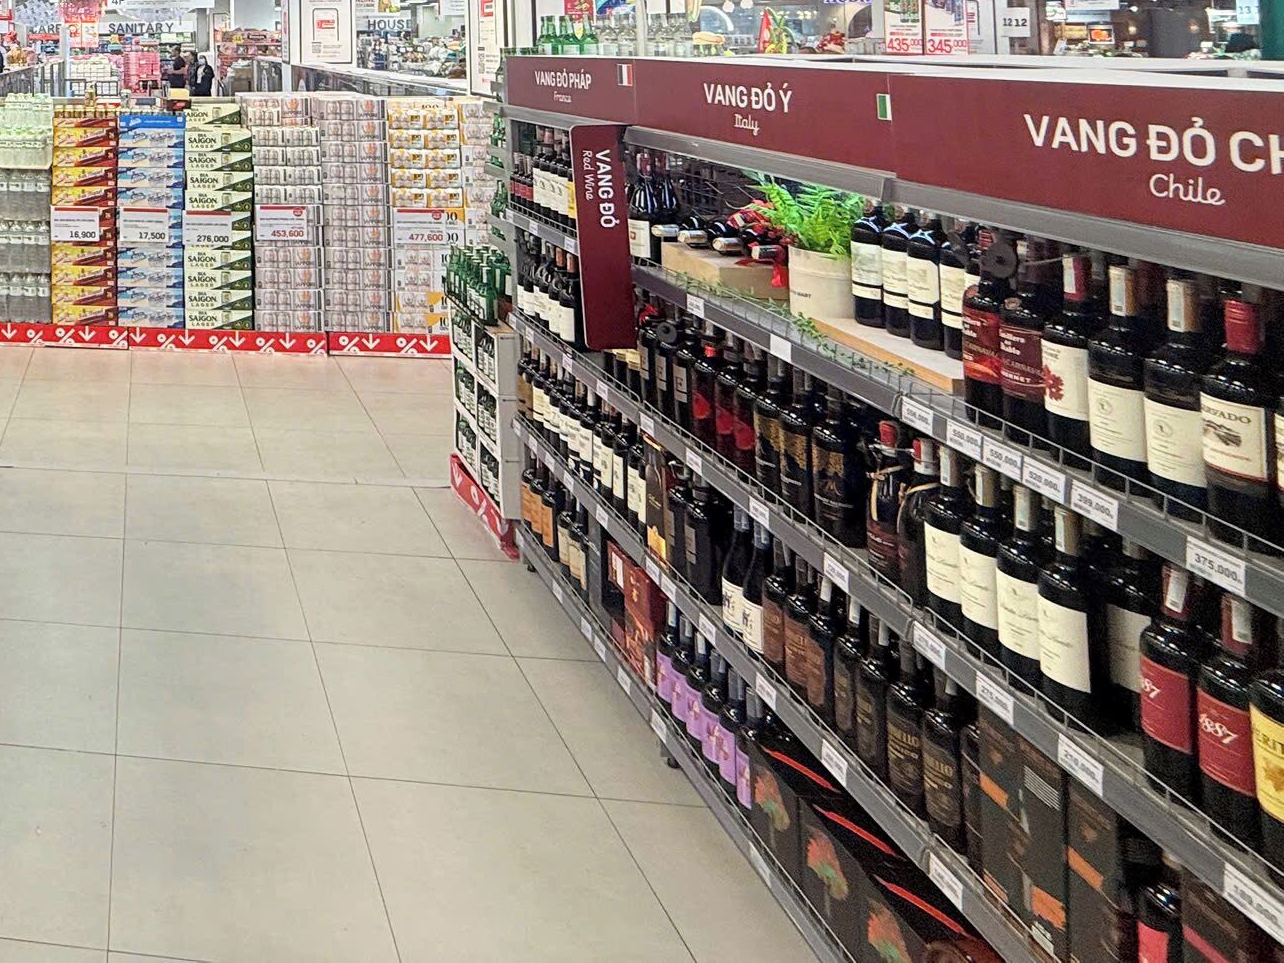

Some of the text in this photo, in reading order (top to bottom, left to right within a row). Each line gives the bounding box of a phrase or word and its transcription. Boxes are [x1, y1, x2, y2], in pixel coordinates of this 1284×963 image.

[108, 22, 174, 34] SANITARY
[1014, 18, 1028, 27] 12
[534, 70, 592, 90] VANG ĐỎ PHÁP
[703, 81, 793, 113] VANG ĐỎ Ý
[733, 113, 760, 136] Italy
[1023, 113, 1138, 158] VANG
[1147, 116, 1216, 167] ĐỎ
[582, 149, 594, 201] Red Wine
[595, 148, 620, 229] VANG ĐỎ
[1149, 173, 1226, 206] Chile
[69, 230, 96, 239] 16,900
[138, 231, 166, 240] 17,500
[271, 230, 304, 238] 453,600
[408, 233, 443, 242] 477,600
